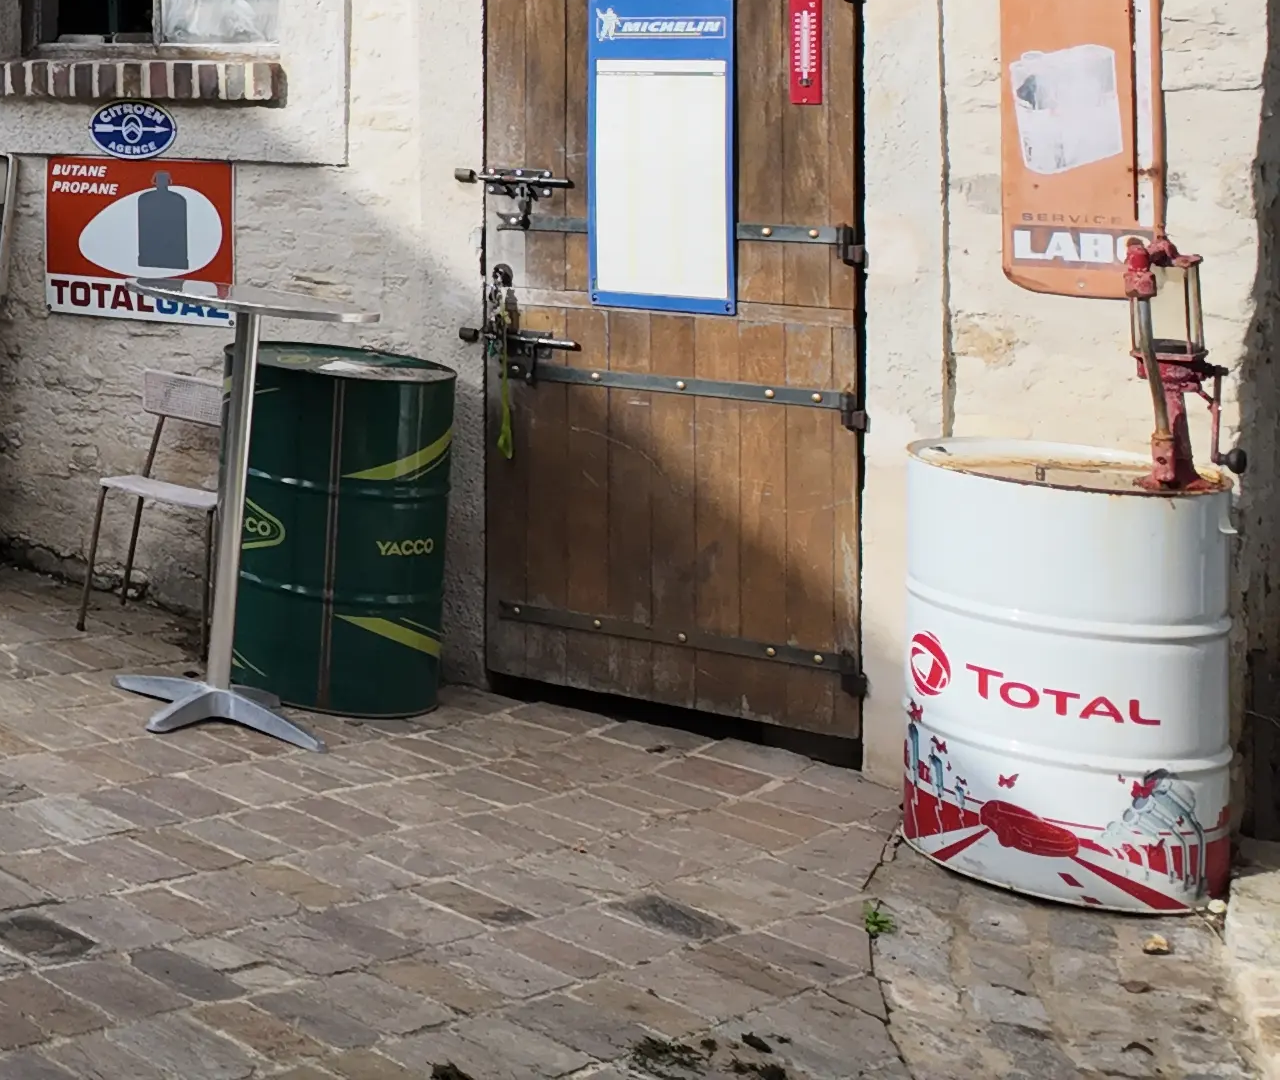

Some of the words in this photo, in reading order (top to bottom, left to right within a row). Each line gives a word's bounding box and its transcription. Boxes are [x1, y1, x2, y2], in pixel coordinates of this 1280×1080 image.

[621, 21, 720, 33] MICHELIN
[108, 141, 157, 155] AGENCE
[51, 164, 107, 178] BUTANE
[51, 181, 118, 195] PROPANE
[1022, 212, 1122, 224] SERVICE
[376, 538, 434, 556] YACCO
[966, 663, 1161, 726] TOTAL
